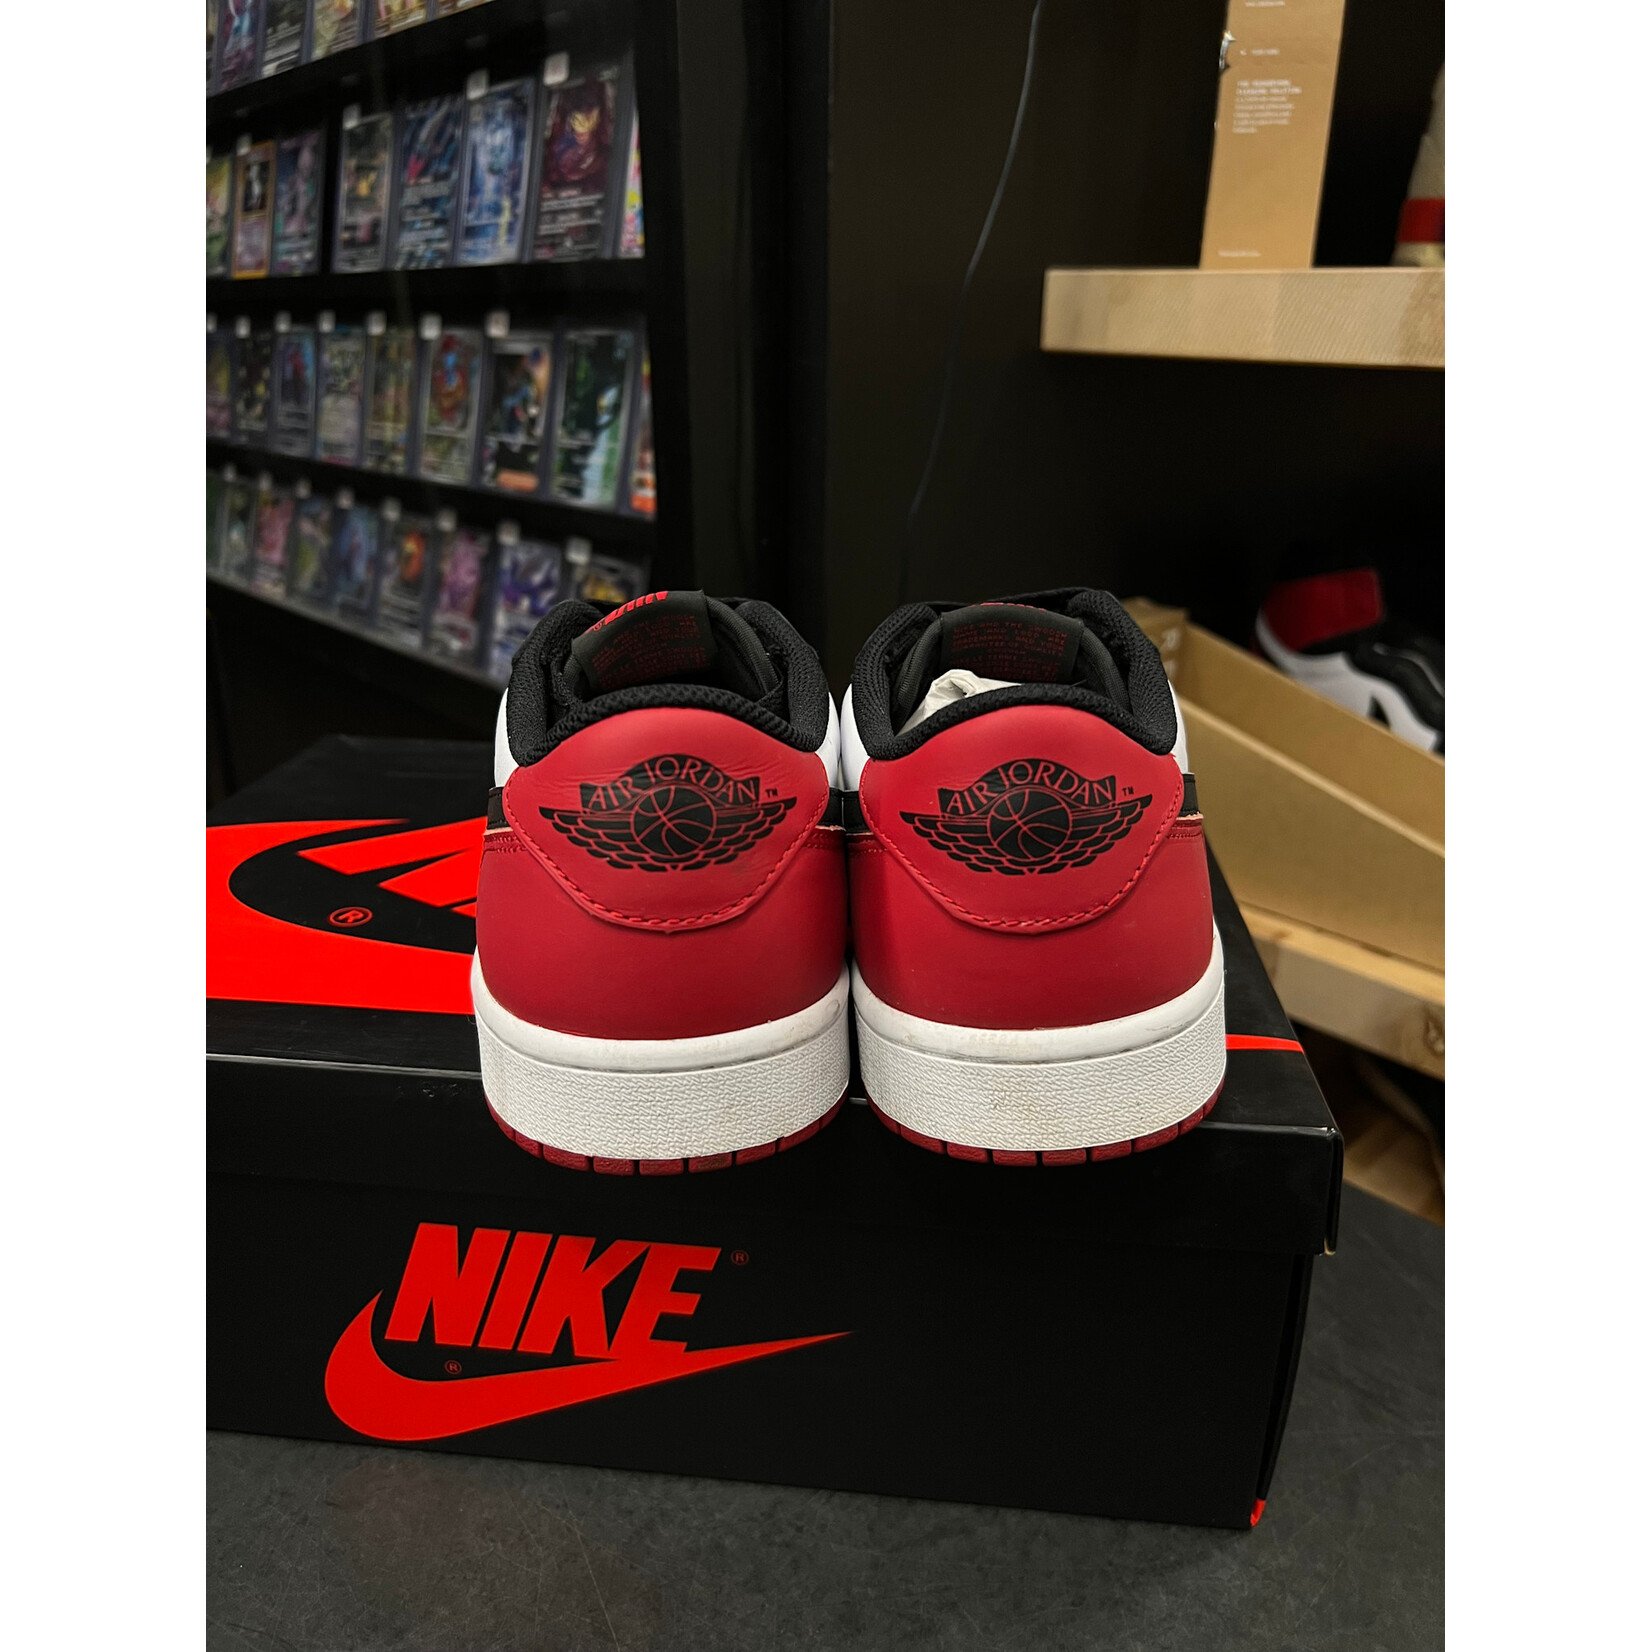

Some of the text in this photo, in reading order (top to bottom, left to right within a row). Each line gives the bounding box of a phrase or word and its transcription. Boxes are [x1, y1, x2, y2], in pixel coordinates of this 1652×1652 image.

[588, 776, 645, 810] AIR
[644, 757, 756, 804] JORDAN
[946, 781, 999, 815] AIR
[998, 761, 1113, 804] JORDAN
[384, 1222, 722, 1361] NIKE
